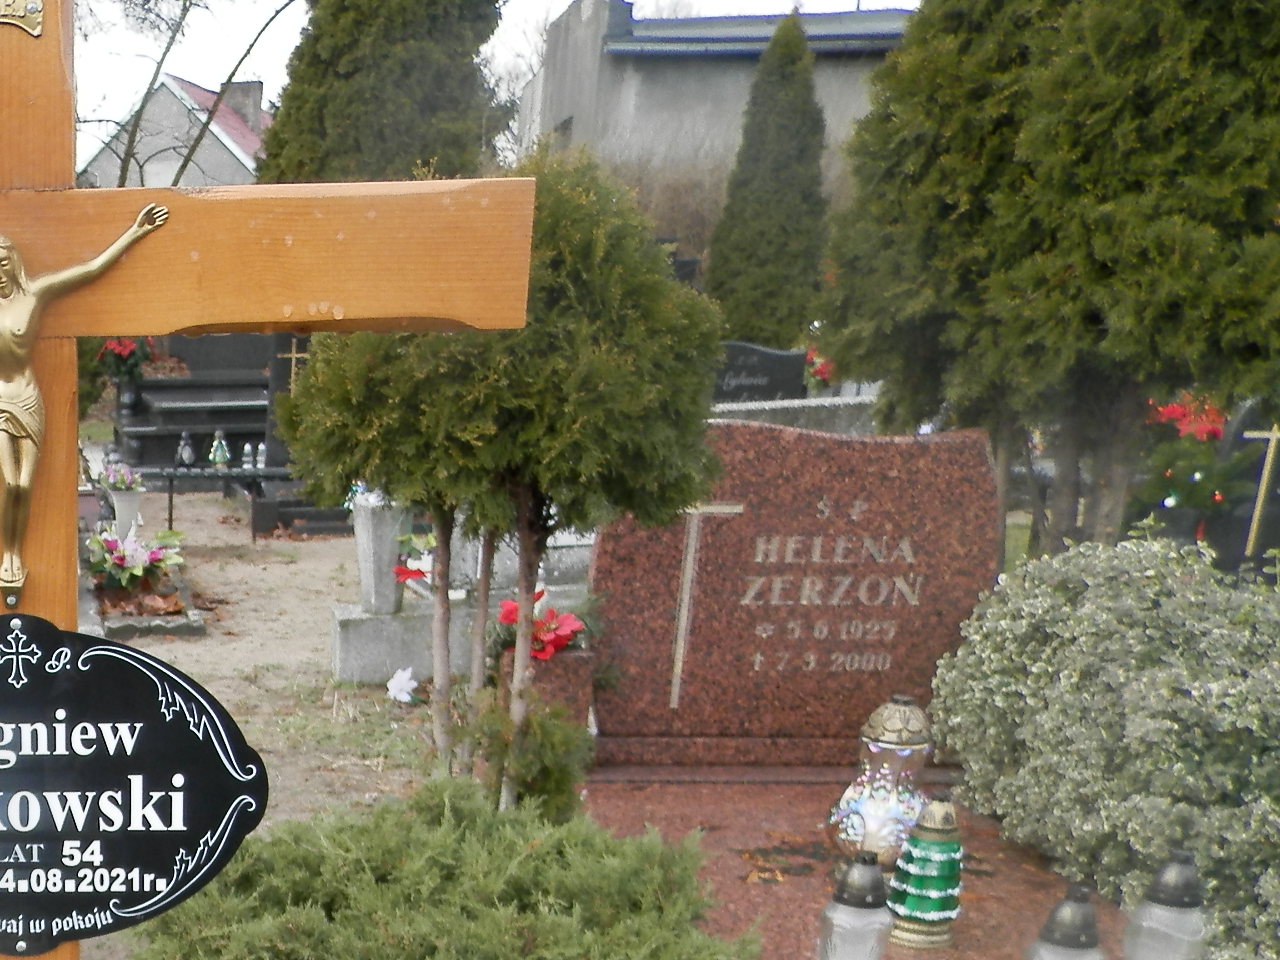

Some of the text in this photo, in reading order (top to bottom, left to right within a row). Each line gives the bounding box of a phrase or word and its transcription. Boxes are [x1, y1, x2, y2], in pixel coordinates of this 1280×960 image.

[754, 535, 916, 564] HELENA
[829, 651, 892, 672] 2000
[61, 839, 104, 867] 54
[29, 917, 46, 934] w
[51, 907, 114, 936] pokoju
